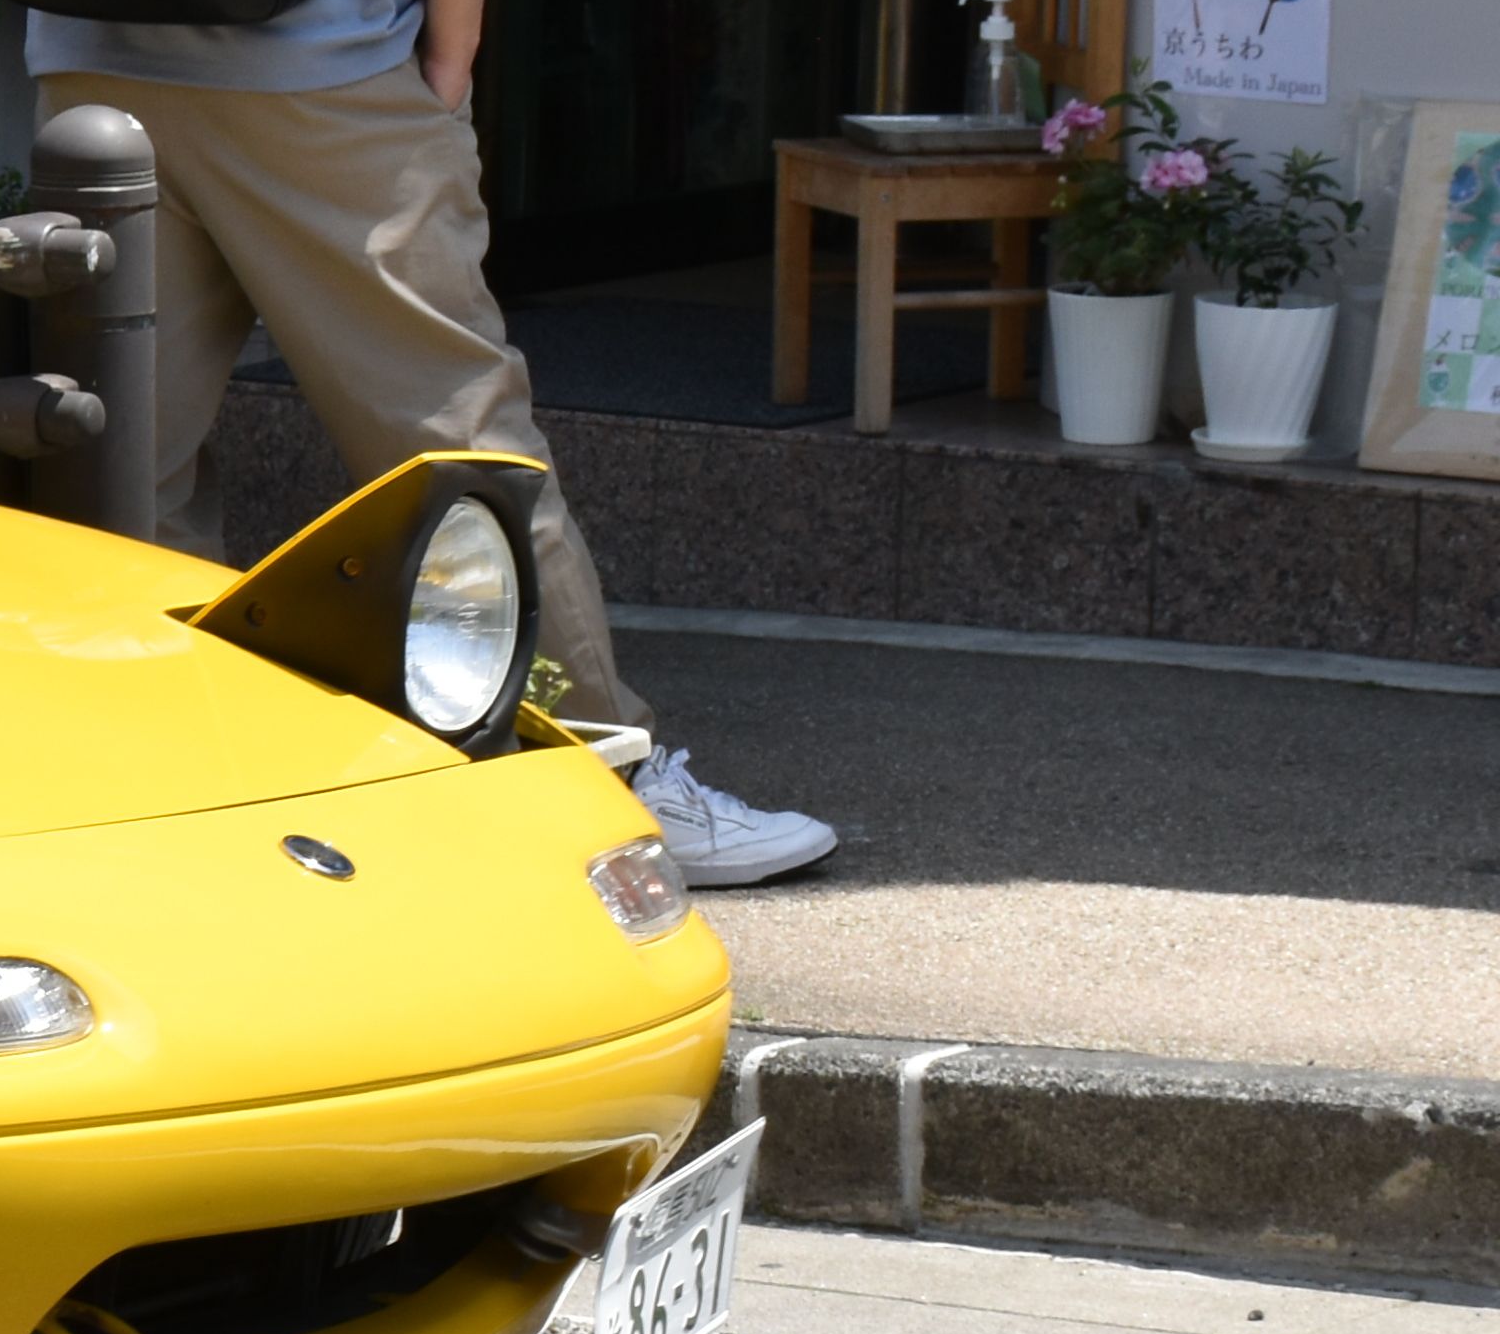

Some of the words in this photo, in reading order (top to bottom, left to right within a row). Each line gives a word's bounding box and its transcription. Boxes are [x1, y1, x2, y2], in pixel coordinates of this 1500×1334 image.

[1164, 27, 1265, 60] 京うちわ
[1184, 66, 1235, 89] Made
[1242, 73, 1260, 91] in
[1266, 73, 1322, 99] Japan
